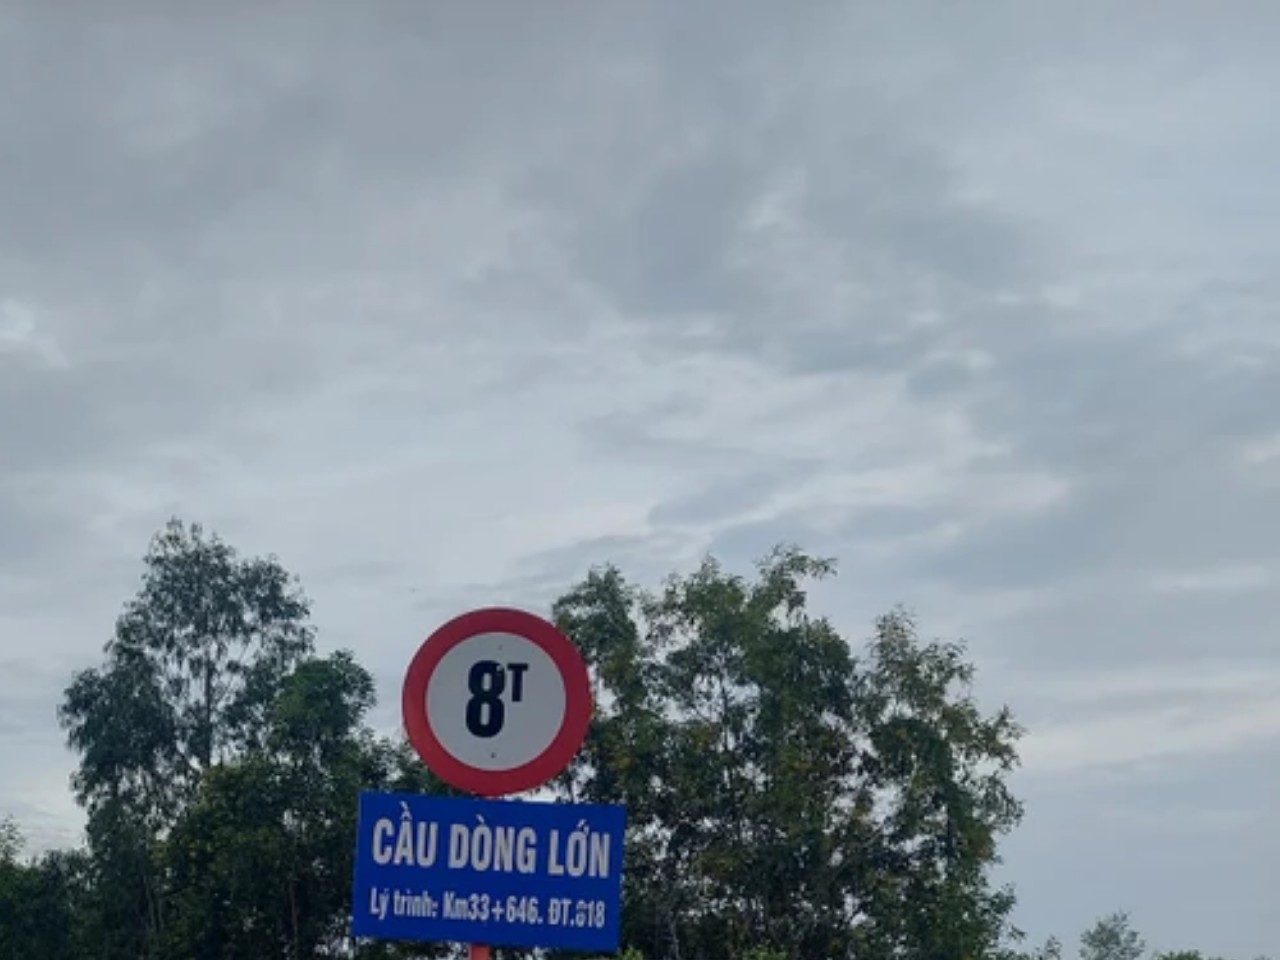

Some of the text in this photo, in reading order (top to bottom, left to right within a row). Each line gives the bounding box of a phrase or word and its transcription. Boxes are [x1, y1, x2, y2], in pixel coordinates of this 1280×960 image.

[372, 800, 611, 879] CẦU DÒNG LỚN
[370, 886, 390, 921] Lý
[393, 888, 439, 918] trình:
